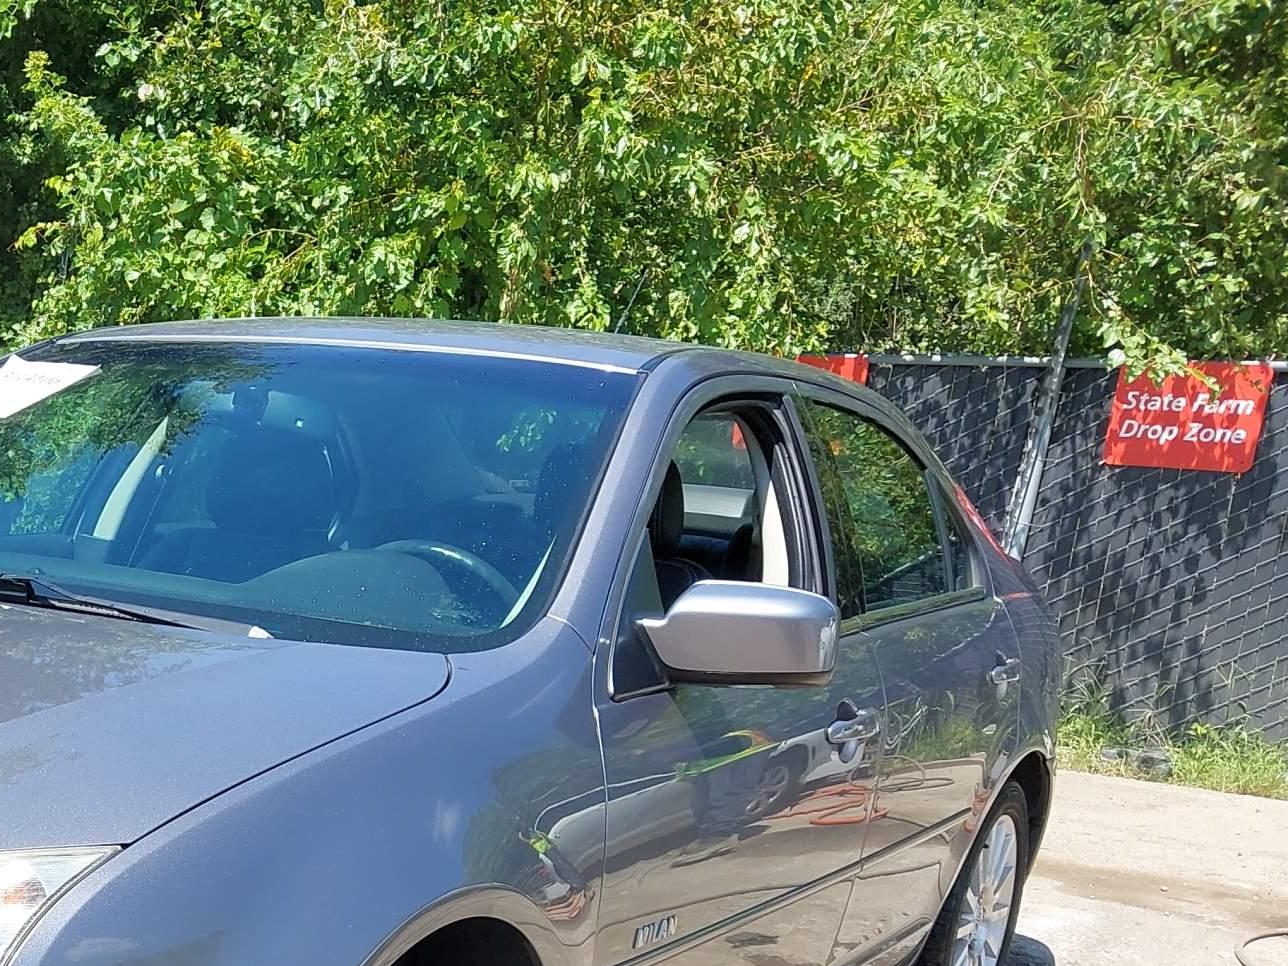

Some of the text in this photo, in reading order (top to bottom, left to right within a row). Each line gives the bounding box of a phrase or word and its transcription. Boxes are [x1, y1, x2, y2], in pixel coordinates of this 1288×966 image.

[1123, 391, 1255, 416] State Farm
[1119, 419, 1247, 445] Drop Zone
[632, 914, 679, 950] MILAN
